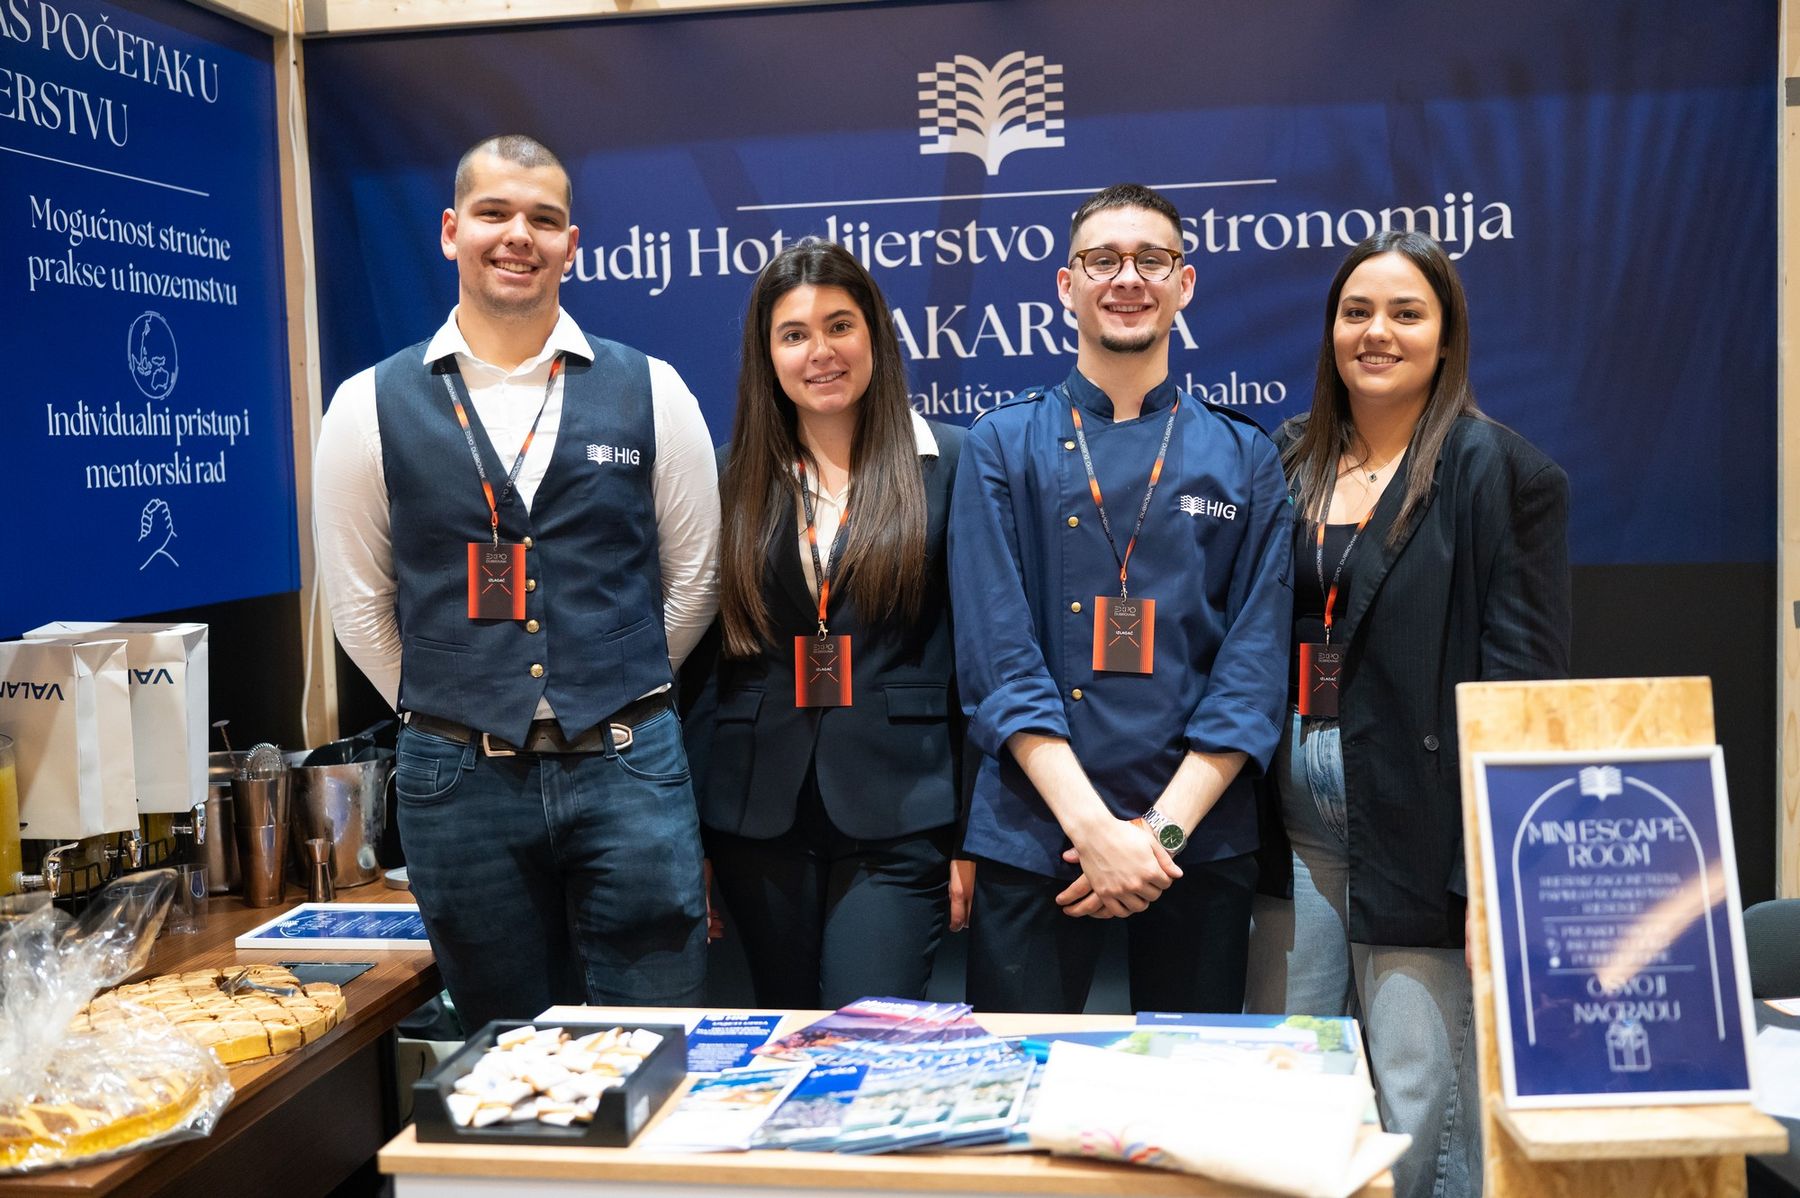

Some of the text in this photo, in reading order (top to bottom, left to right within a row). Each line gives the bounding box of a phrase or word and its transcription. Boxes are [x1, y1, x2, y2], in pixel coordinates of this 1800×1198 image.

[40, 2, 194, 98] POČETAK
[198, 58, 219, 104] U
[29, 194, 231, 262] Mogućnost stručne
[560, 192, 1515, 296] udij Hotlijerstvo stronomija
[28, 249, 238, 306] prakse u inozemstvu
[891, 302, 1200, 361] AKARSA
[907, 371, 1287, 416] aktičn balno
[47, 400, 250, 446] Individualni pristup i
[1161, 414, 1176, 442] DUBROVNIK
[86, 450, 226, 489] mentorski rad
[468, 445, 487, 479] DUBROVNIK
[504, 454, 525, 488] DUBROVNIK
[614, 447, 641, 466] HIG
[1138, 485, 1154, 519] DUBROVNIK
[1206, 500, 1238, 521] HIG
[1338, 531, 1359, 567] DUBROVNIK
[1526, 816, 1688, 845] MINI ESCAPE
[1567, 842, 1651, 869] ROOM
